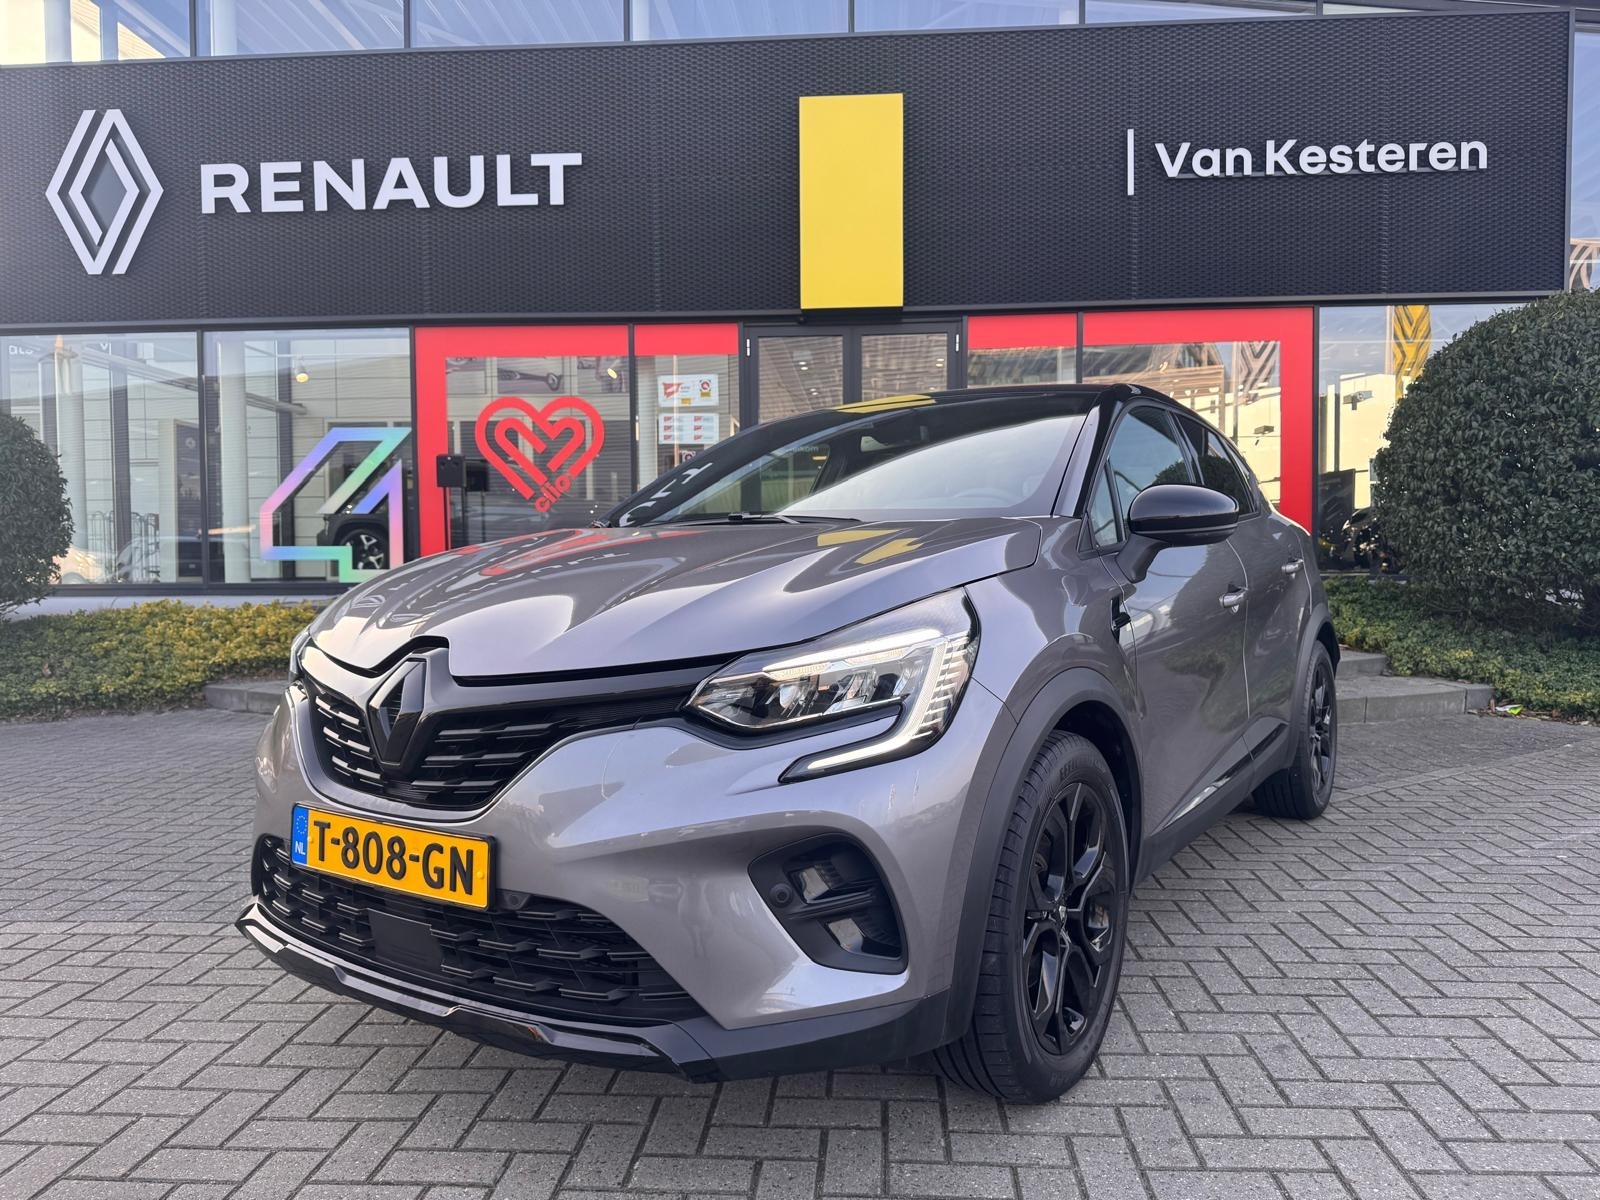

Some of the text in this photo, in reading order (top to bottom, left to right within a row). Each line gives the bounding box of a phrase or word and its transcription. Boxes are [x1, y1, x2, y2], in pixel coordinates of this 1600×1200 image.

[1154, 138, 1488, 178] Van Kesteren
[200, 152, 583, 214] RENAULT
[535, 475, 571, 512] clio
[295, 840, 306, 855] NL
[313, 820, 474, 896] T-808-GN
